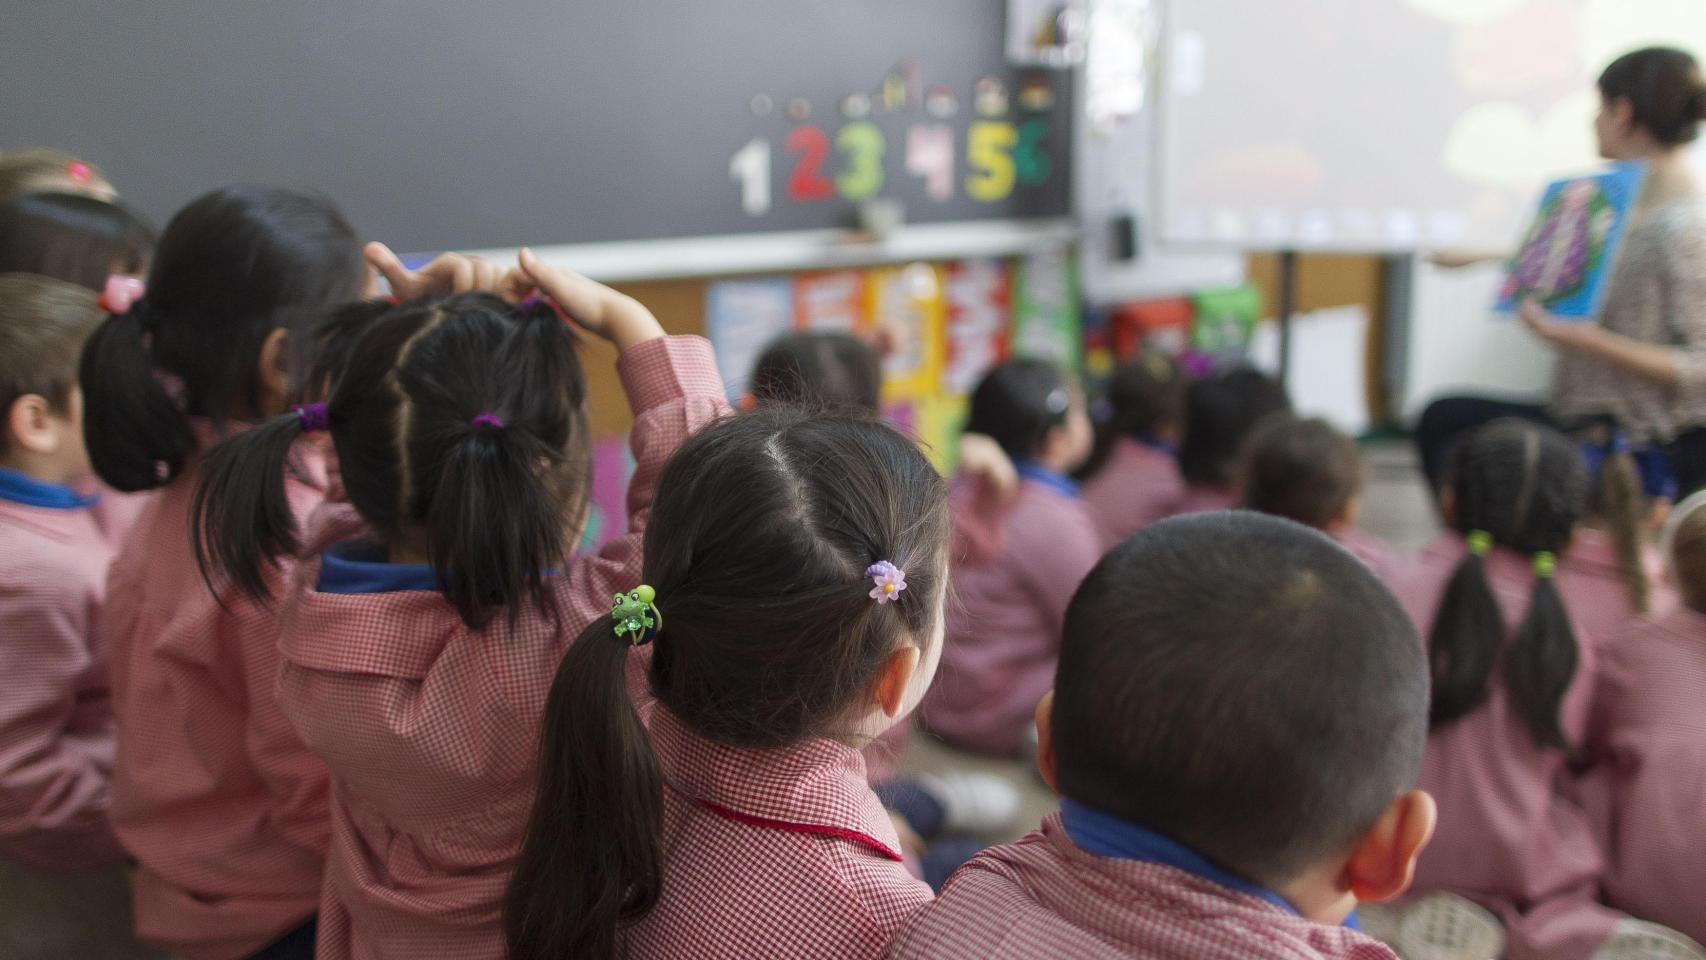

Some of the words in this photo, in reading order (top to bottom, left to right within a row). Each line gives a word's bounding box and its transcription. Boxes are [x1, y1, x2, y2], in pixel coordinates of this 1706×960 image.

[731, 138, 771, 214] 1
[786, 126, 833, 201] 2
[836, 121, 884, 201] 3
[906, 125, 953, 201] 4
[967, 121, 1016, 201] 5
[1014, 118, 1051, 184] 6
